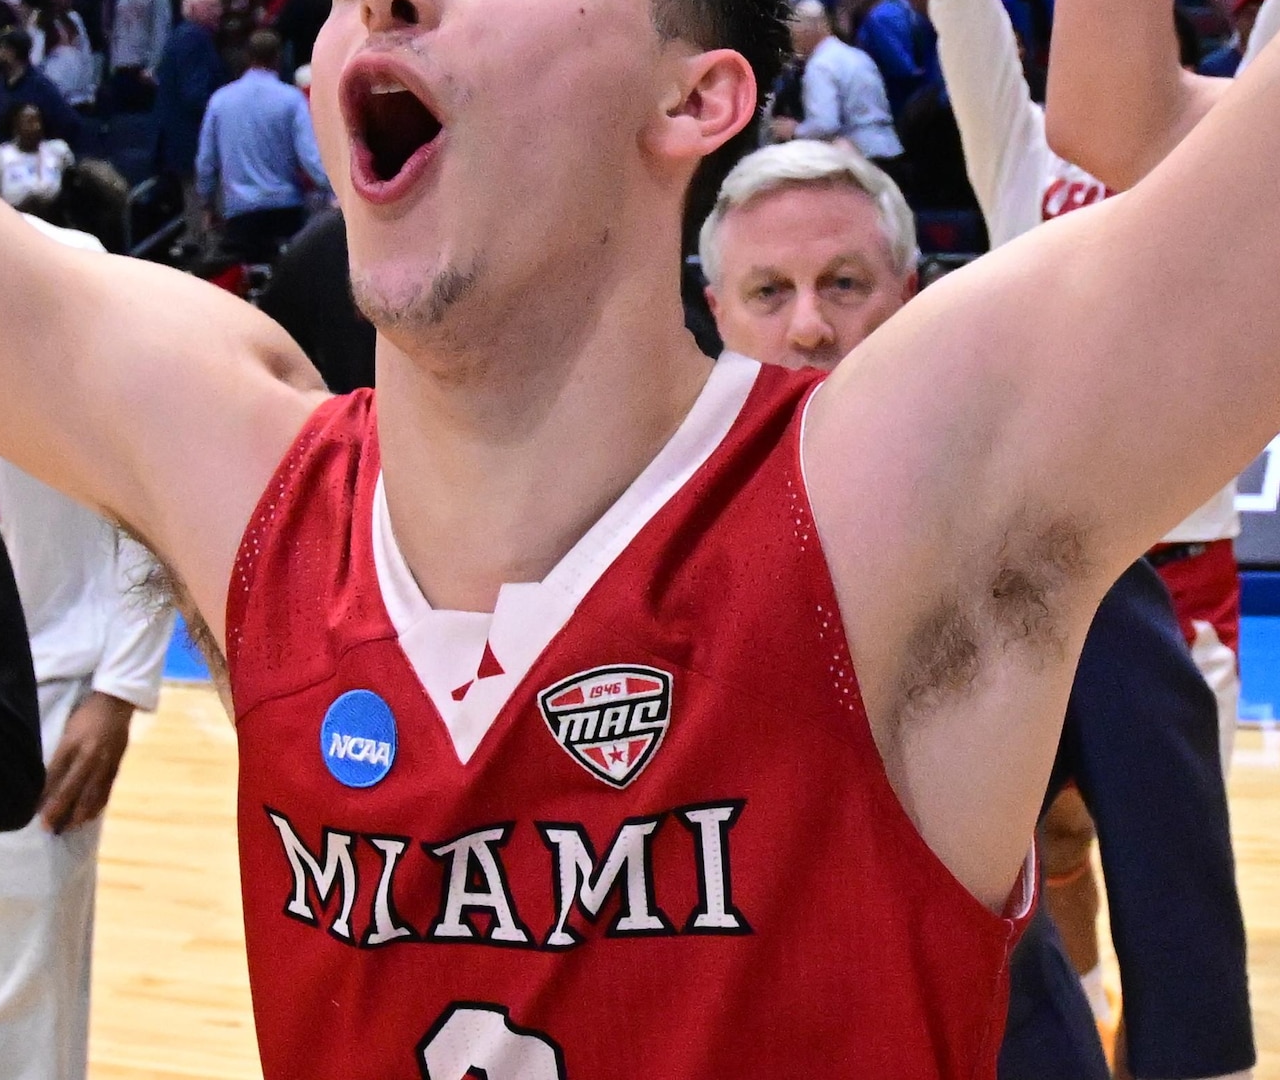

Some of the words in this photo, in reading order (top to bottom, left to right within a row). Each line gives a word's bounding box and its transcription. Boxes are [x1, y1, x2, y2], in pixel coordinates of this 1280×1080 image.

[589, 682, 622, 699] 1946
[557, 700, 669, 745] MAC
[328, 732, 392, 767] NCAA
[266, 801, 751, 948] MIAMI
